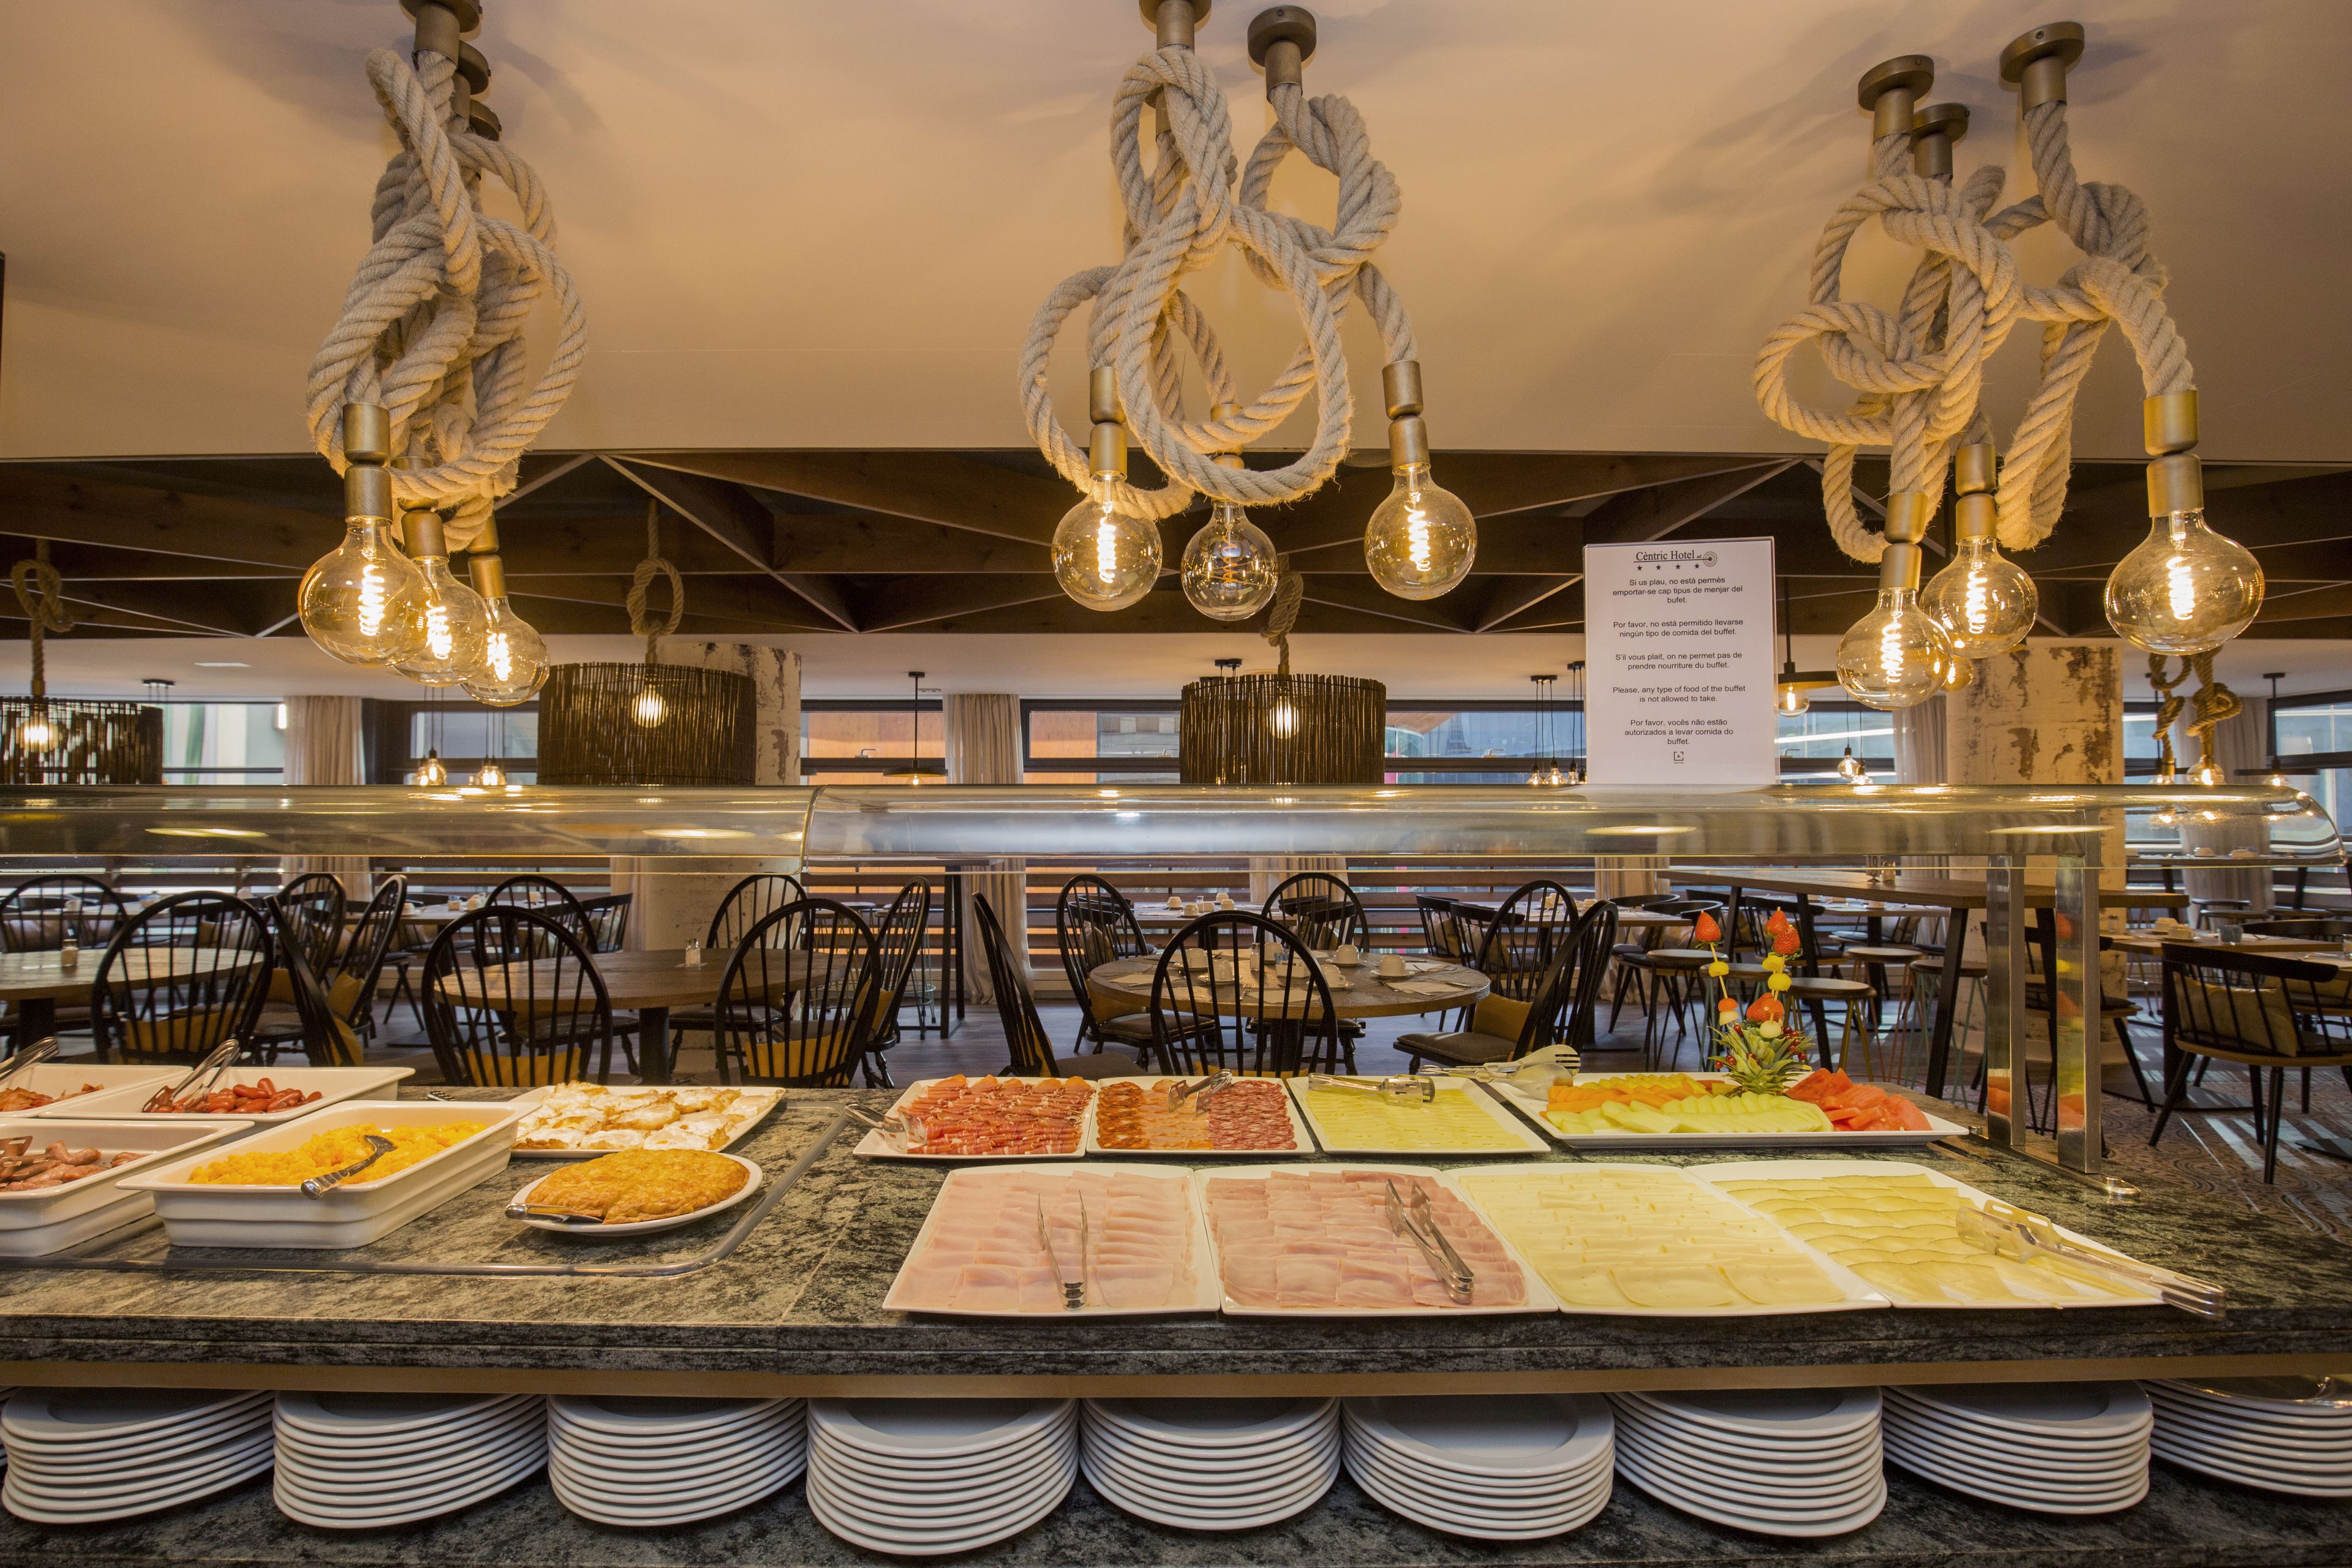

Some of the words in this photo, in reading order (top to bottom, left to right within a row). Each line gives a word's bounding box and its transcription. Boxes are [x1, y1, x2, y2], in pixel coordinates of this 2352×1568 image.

[1636, 551, 1668, 560] Cèntric
[1671, 550, 1695, 559] Hotel
[1698, 576, 1725, 585] permès
